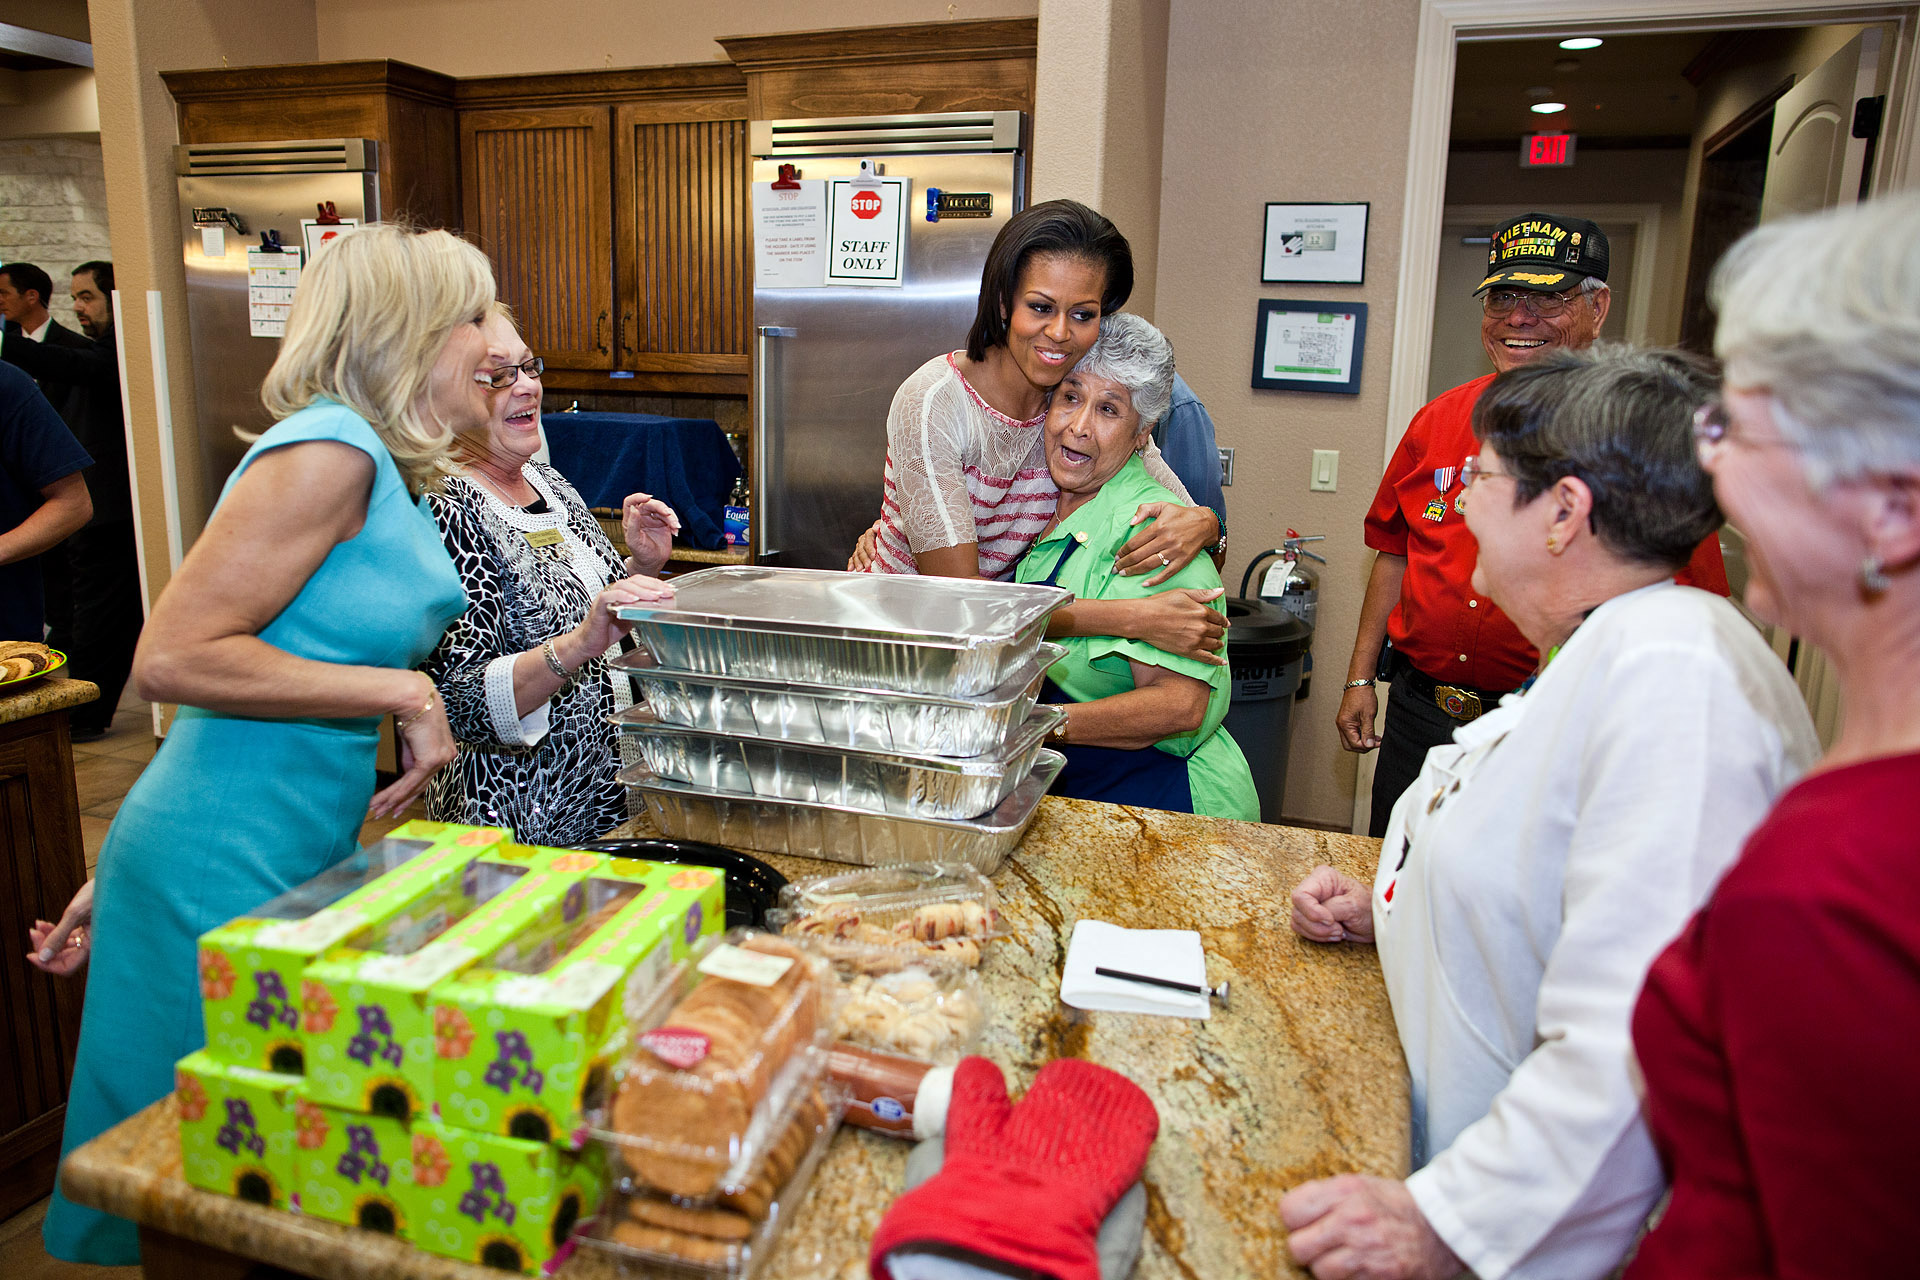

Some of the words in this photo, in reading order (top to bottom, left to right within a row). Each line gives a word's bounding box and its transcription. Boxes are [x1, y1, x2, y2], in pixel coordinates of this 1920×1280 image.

[1529, 135, 1569, 164] EXIT
[779, 192, 799, 201] STOP
[941, 196, 989, 209] VIKING
[851, 199, 881, 211] STOP
[193, 209, 224, 221] VIKIN
[1500, 221, 1567, 244] VIETNAM
[840, 240, 890, 253] STAFF
[1501, 245, 1556, 260] VETERAN
[843, 257, 887, 270] ONLY
[726, 509, 749, 522] Equal
